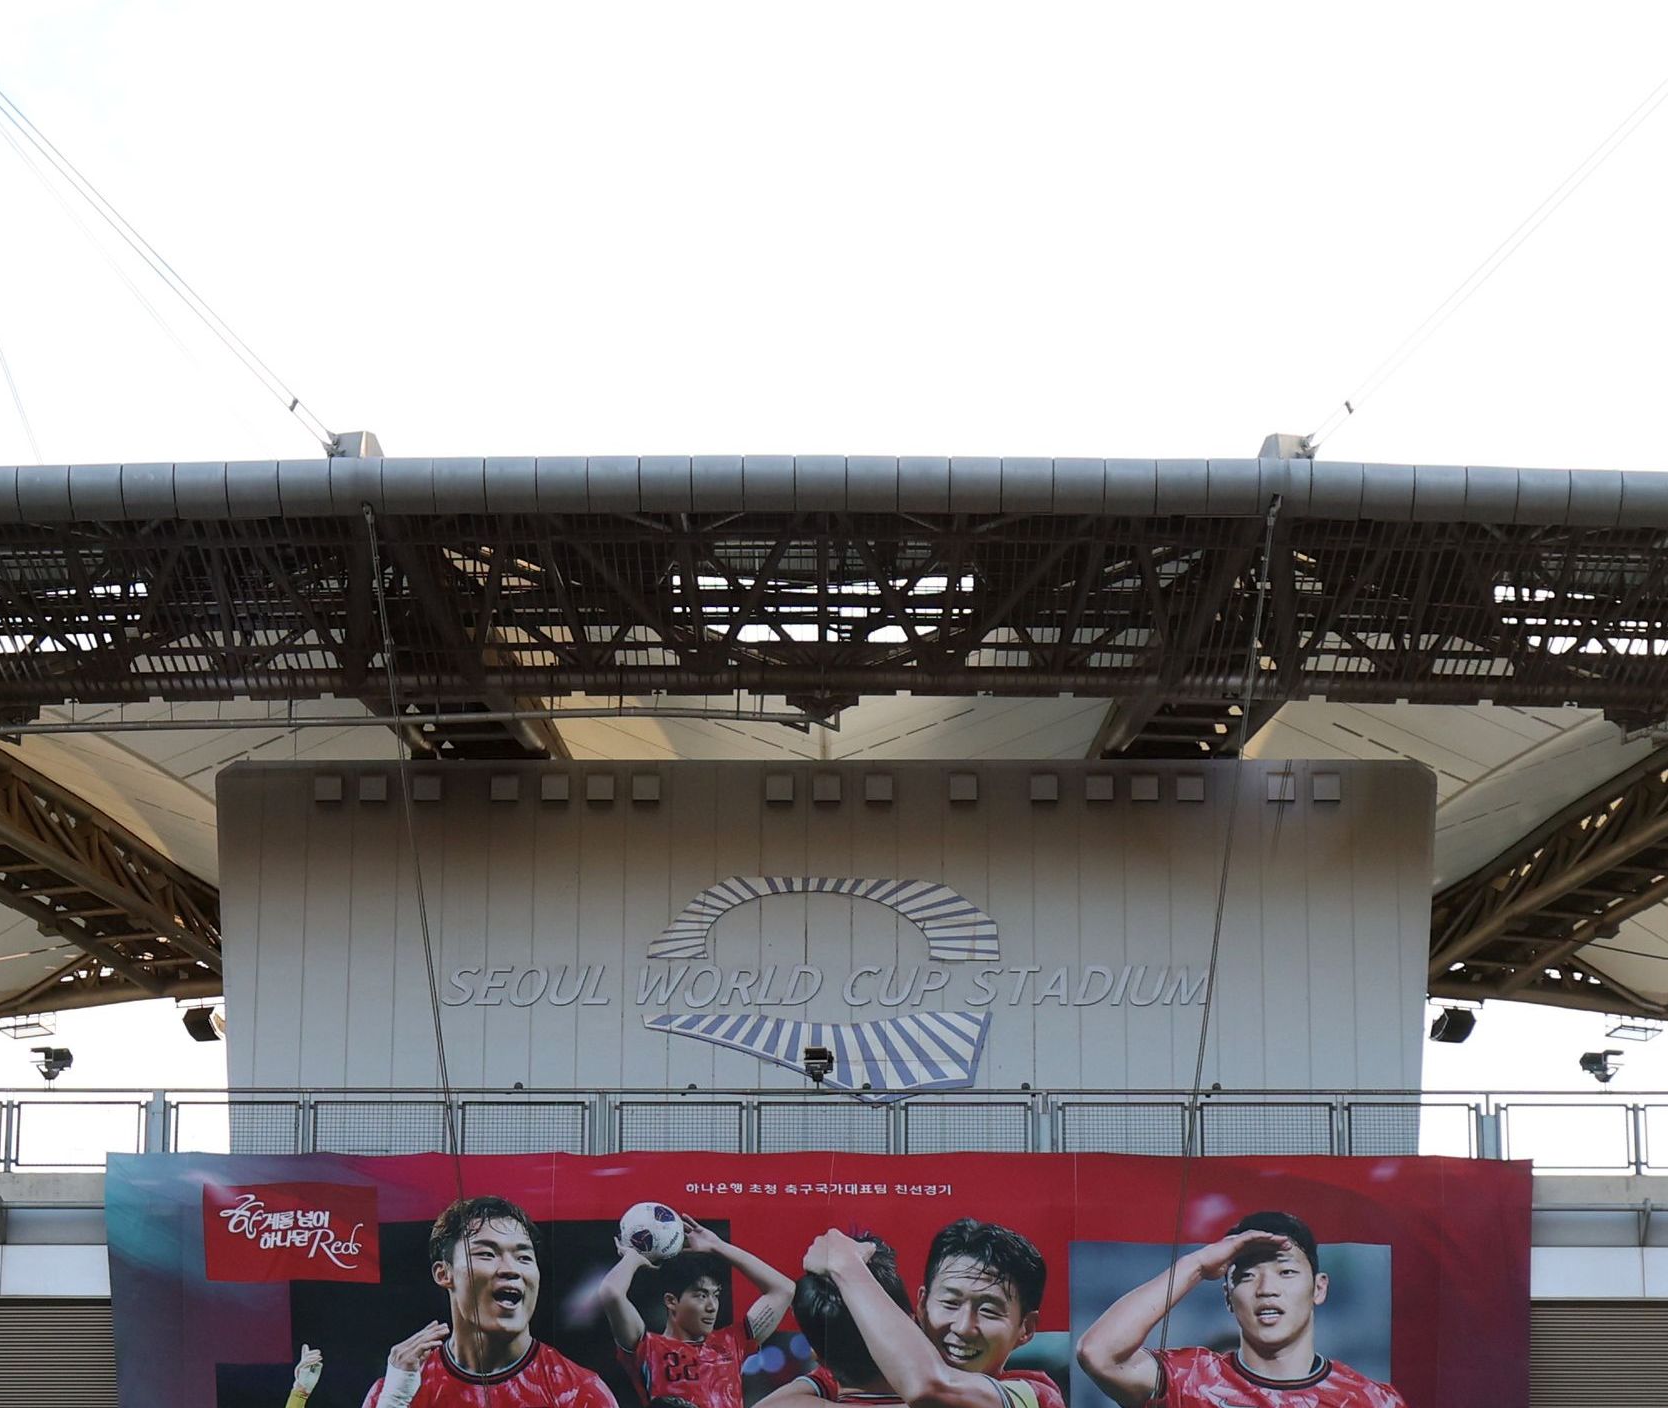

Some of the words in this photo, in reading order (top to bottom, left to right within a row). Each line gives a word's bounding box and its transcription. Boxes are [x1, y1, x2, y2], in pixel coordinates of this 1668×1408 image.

[441, 964, 612, 1008] SEOUL
[634, 964, 823, 1008] WORLD
[842, 964, 953, 1008] CUP
[972, 964, 1210, 1008] STADIUM
[685, 1182, 743, 1195] 하나은행
[748, 1183, 778, 1195] 초청
[784, 1183, 888, 1196] 축구국가대표팀
[894, 1184, 953, 1197] 친선경기
[296, 1210, 330, 1229] 넘어
[259, 1230, 310, 1250] 하나된
[308, 1223, 364, 1270] Reds
